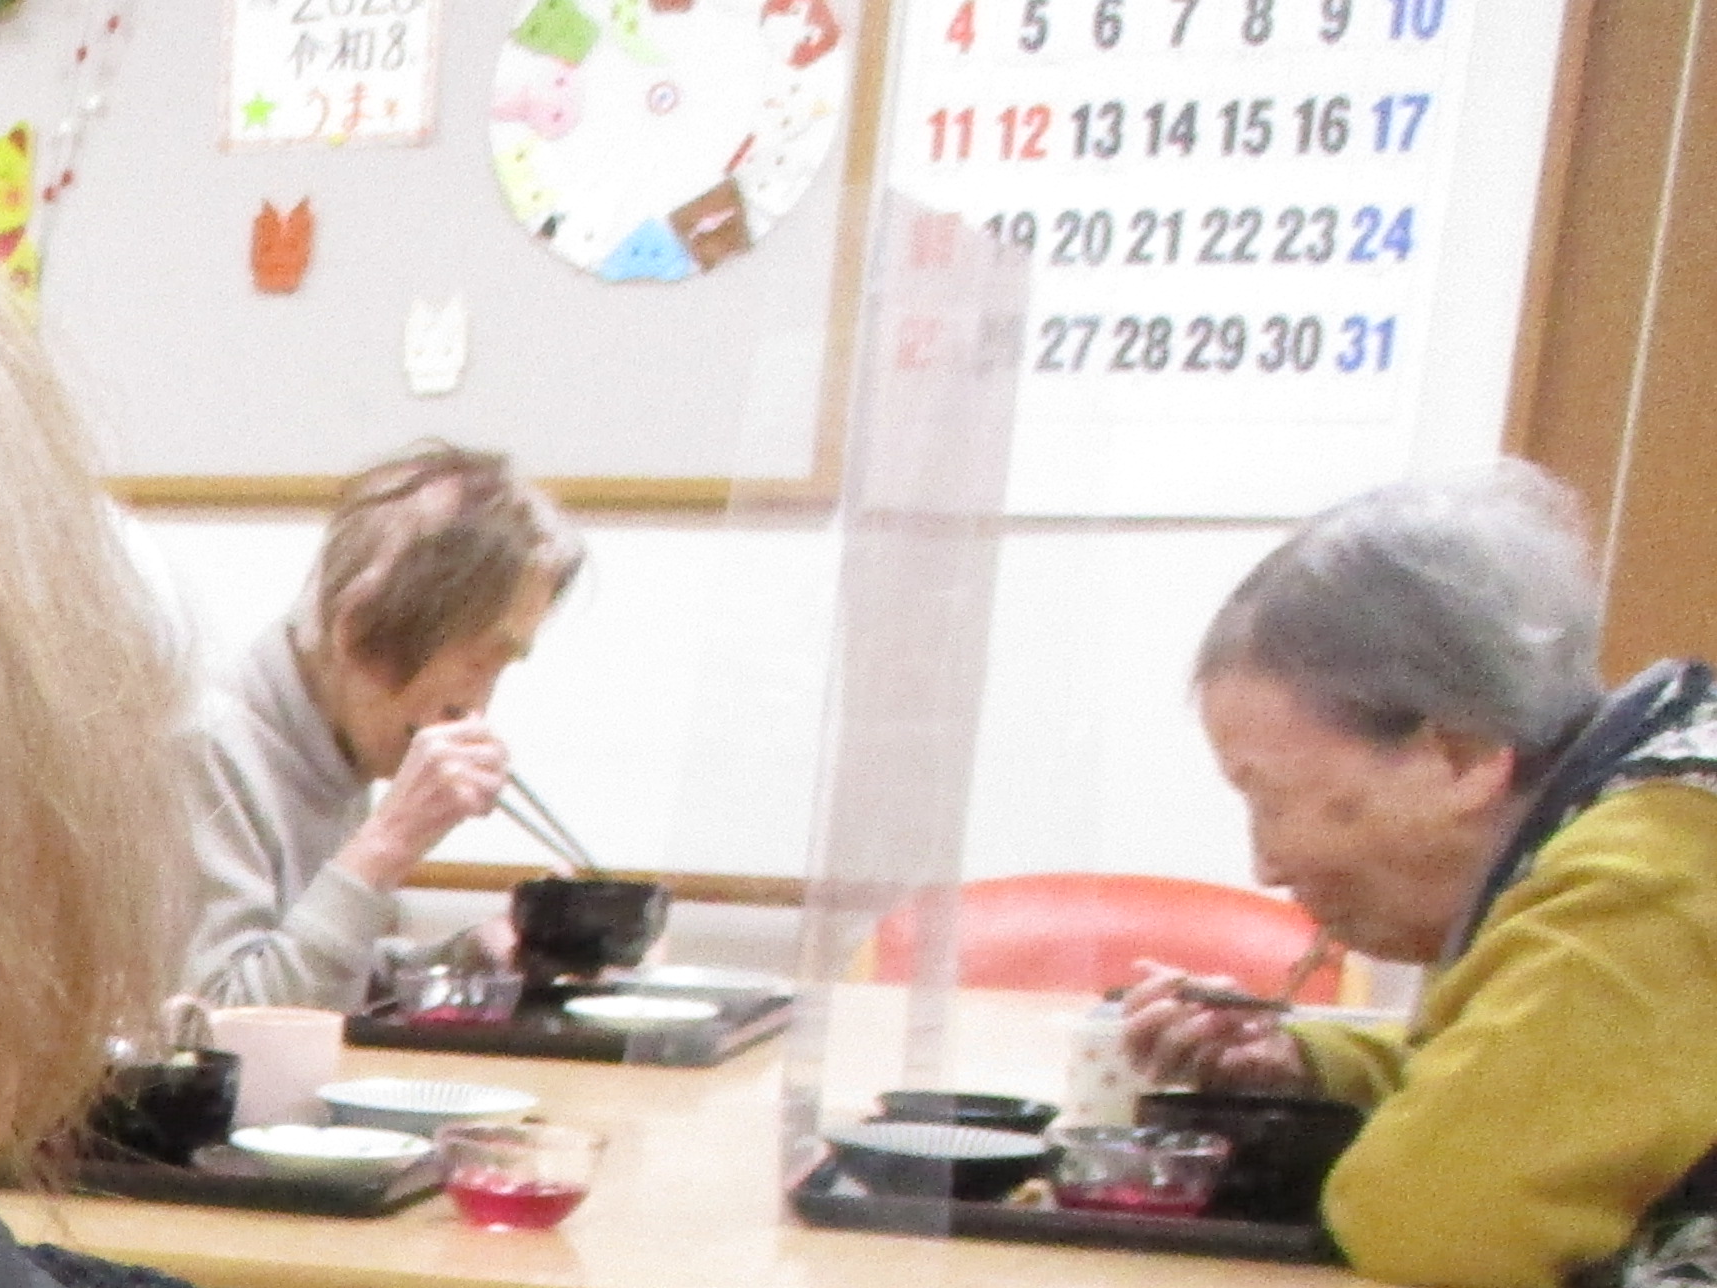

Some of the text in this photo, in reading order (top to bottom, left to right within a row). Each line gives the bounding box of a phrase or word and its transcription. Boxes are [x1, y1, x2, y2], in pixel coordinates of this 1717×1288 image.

[946, 0, 1445, 53] 4 5 6 7 8 9 10
[926, 94, 1431, 162] 11 12 13 14 15 16 17
[1050, 207, 1114, 266] 20
[1124, 207, 1184, 265] 21
[1195, 206, 1264, 264] 22
[1268, 205, 1339, 264] 23
[1345, 203, 1415, 264] 24
[1034, 314, 1102, 373] 27
[1108, 314, 1173, 372] 28
[1180, 314, 1247, 372] 29
[1257, 314, 1323, 373] 30
[1334, 314, 1396, 373] 31
